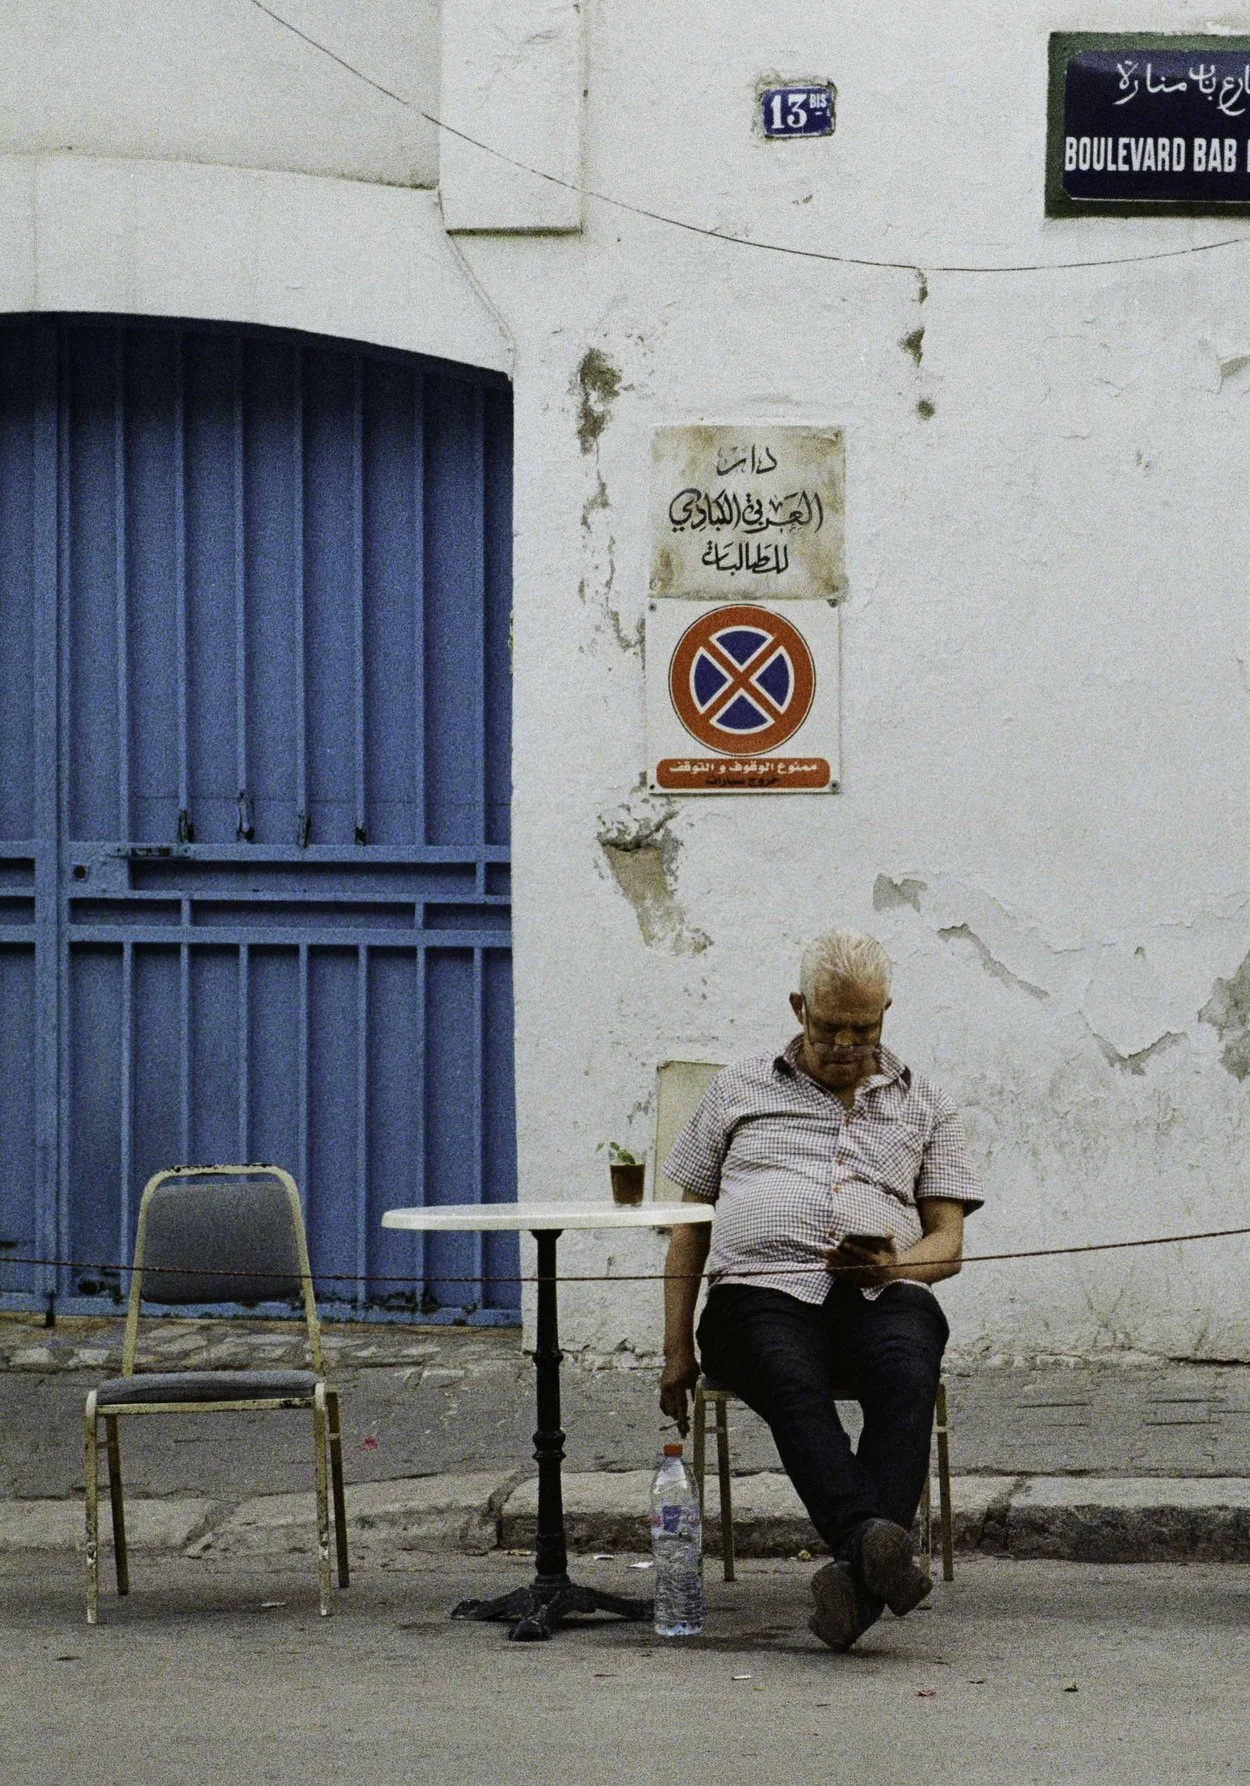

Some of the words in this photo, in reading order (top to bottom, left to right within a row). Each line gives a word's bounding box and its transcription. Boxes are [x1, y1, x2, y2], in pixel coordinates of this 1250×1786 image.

[1113, 60, 1188, 105] منارة
[770, 93, 808, 129] 13
[1064, 136, 1186, 172] BOULEVARD
[1193, 137, 1237, 173] BAB
[716, 443, 777, 476] دار
[669, 760, 714, 775] التوقف
[718, 764, 726, 774] و
[729, 760, 774, 774] الوقوف
[777, 761, 817, 774] ممنوع
